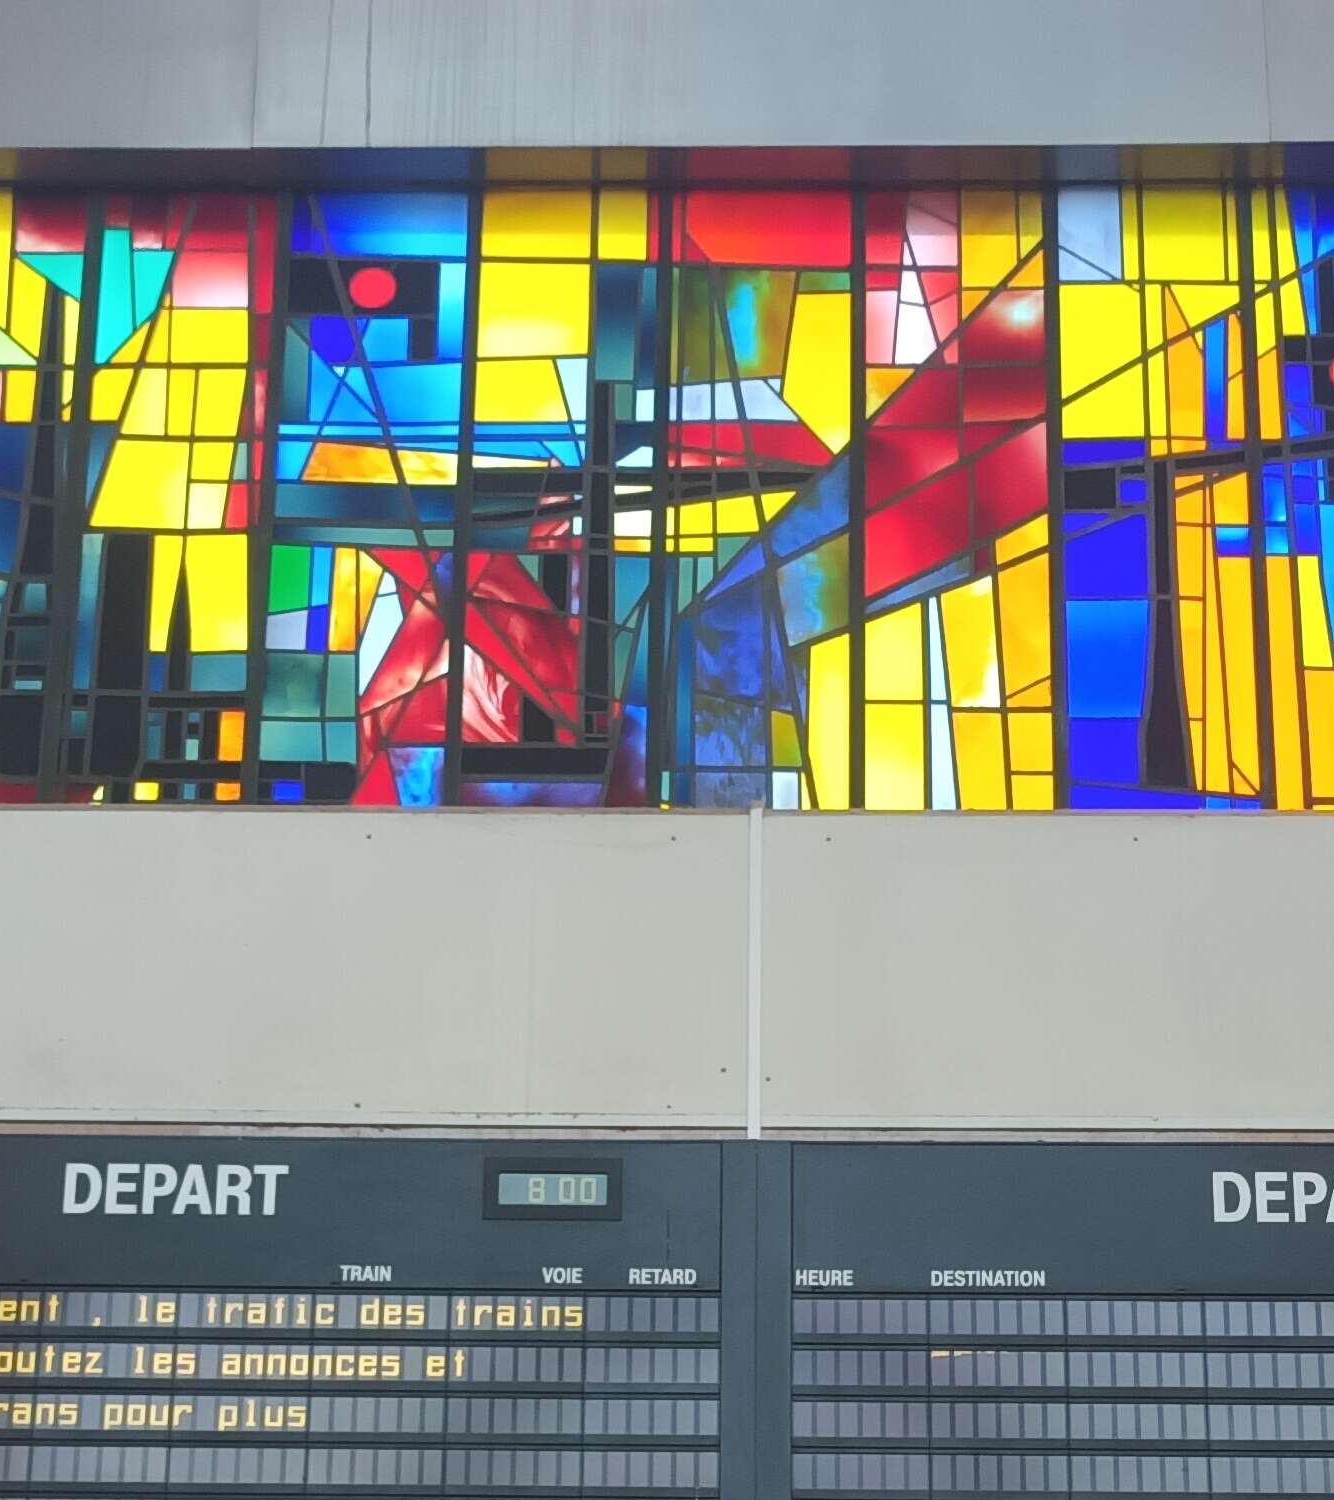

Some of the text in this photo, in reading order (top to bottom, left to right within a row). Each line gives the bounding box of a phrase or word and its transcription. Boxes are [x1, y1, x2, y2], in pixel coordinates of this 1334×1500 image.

[62, 1163, 290, 1216] DEPART
[339, 1265, 392, 1283] TRAIN
[542, 1267, 583, 1284] VOIE
[628, 1268, 697, 1286] RETARD
[795, 1269, 854, 1286] HEURE
[930, 1270, 1046, 1287] DESTINATION
[137, 1295, 177, 1324] le
[207, 1297, 335, 1326] trafic
[360, 1298, 426, 1327] des
[456, 1299, 584, 1328] trains
[133, 1347, 196, 1376] les
[222, 1351, 401, 1378] annonces
[425, 1351, 466, 1378] et
[103, 1400, 193, 1431] pour
[217, 1399, 308, 1431] plus
